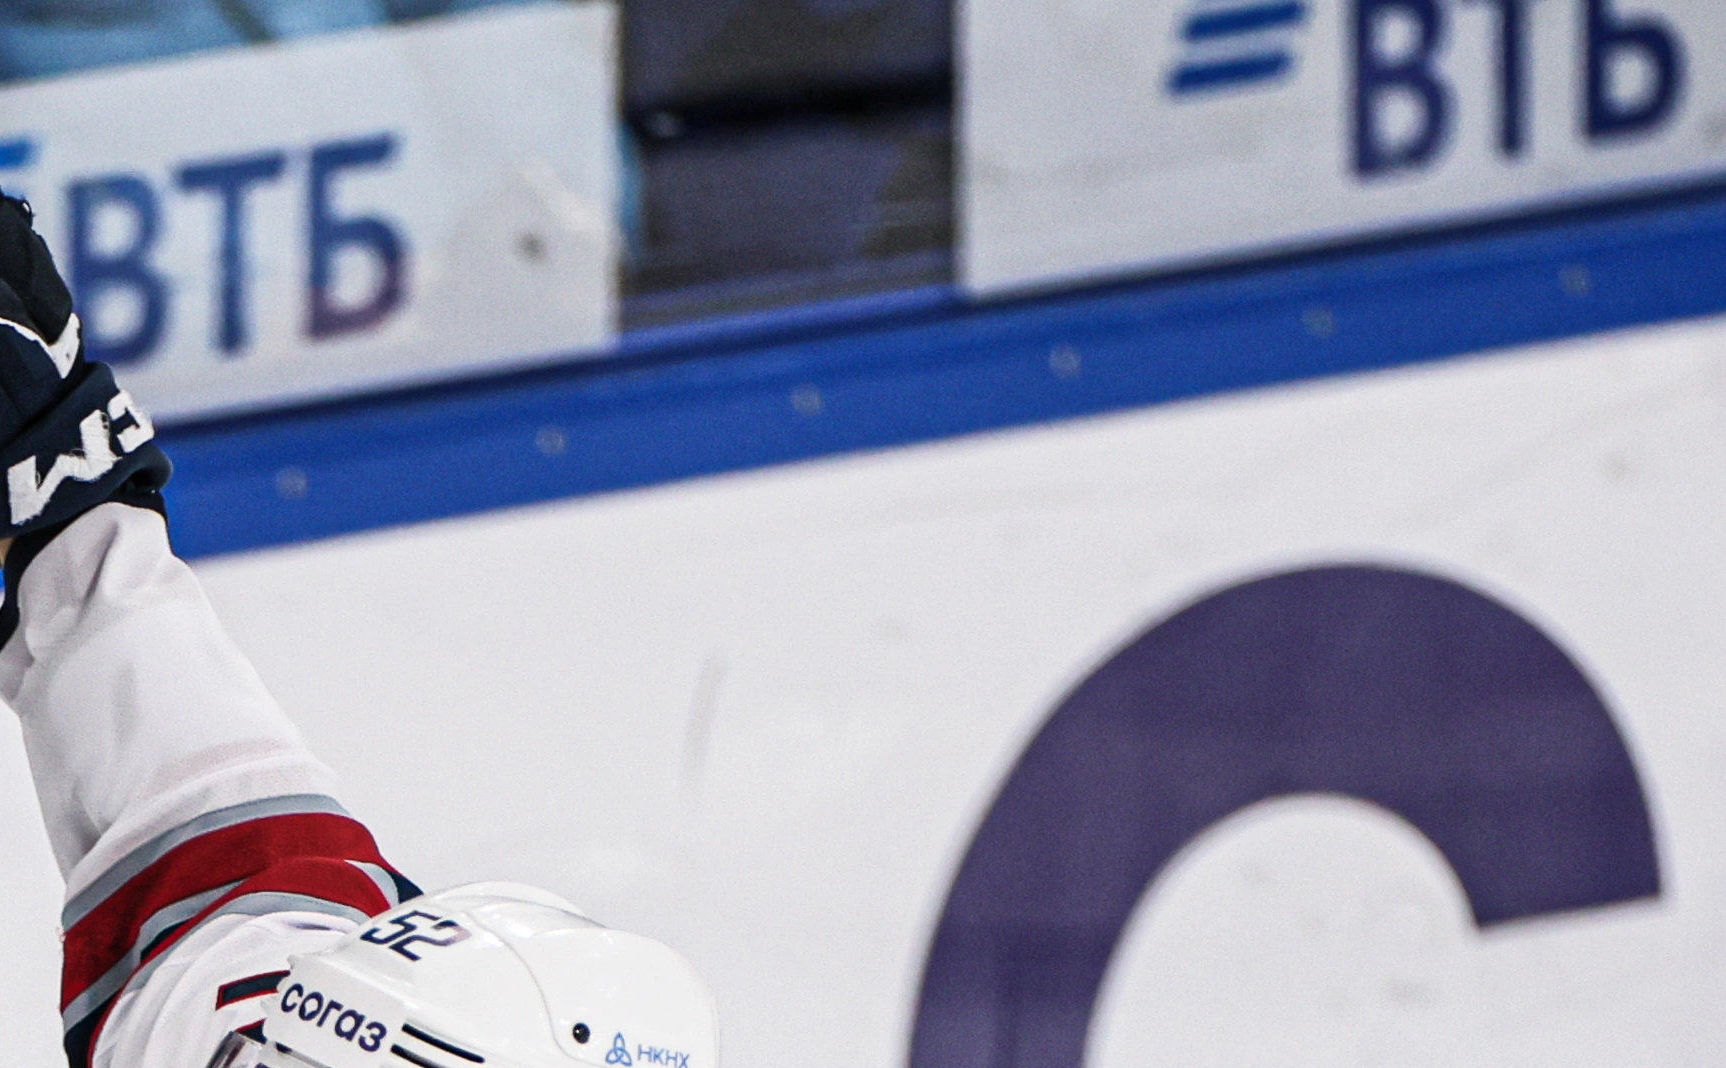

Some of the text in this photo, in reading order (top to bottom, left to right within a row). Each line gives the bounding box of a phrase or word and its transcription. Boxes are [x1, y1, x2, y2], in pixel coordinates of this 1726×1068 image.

[67, 132, 414, 368] ВТБ
[360, 910, 472, 961] 52
[281, 983, 387, 1052] согаз
